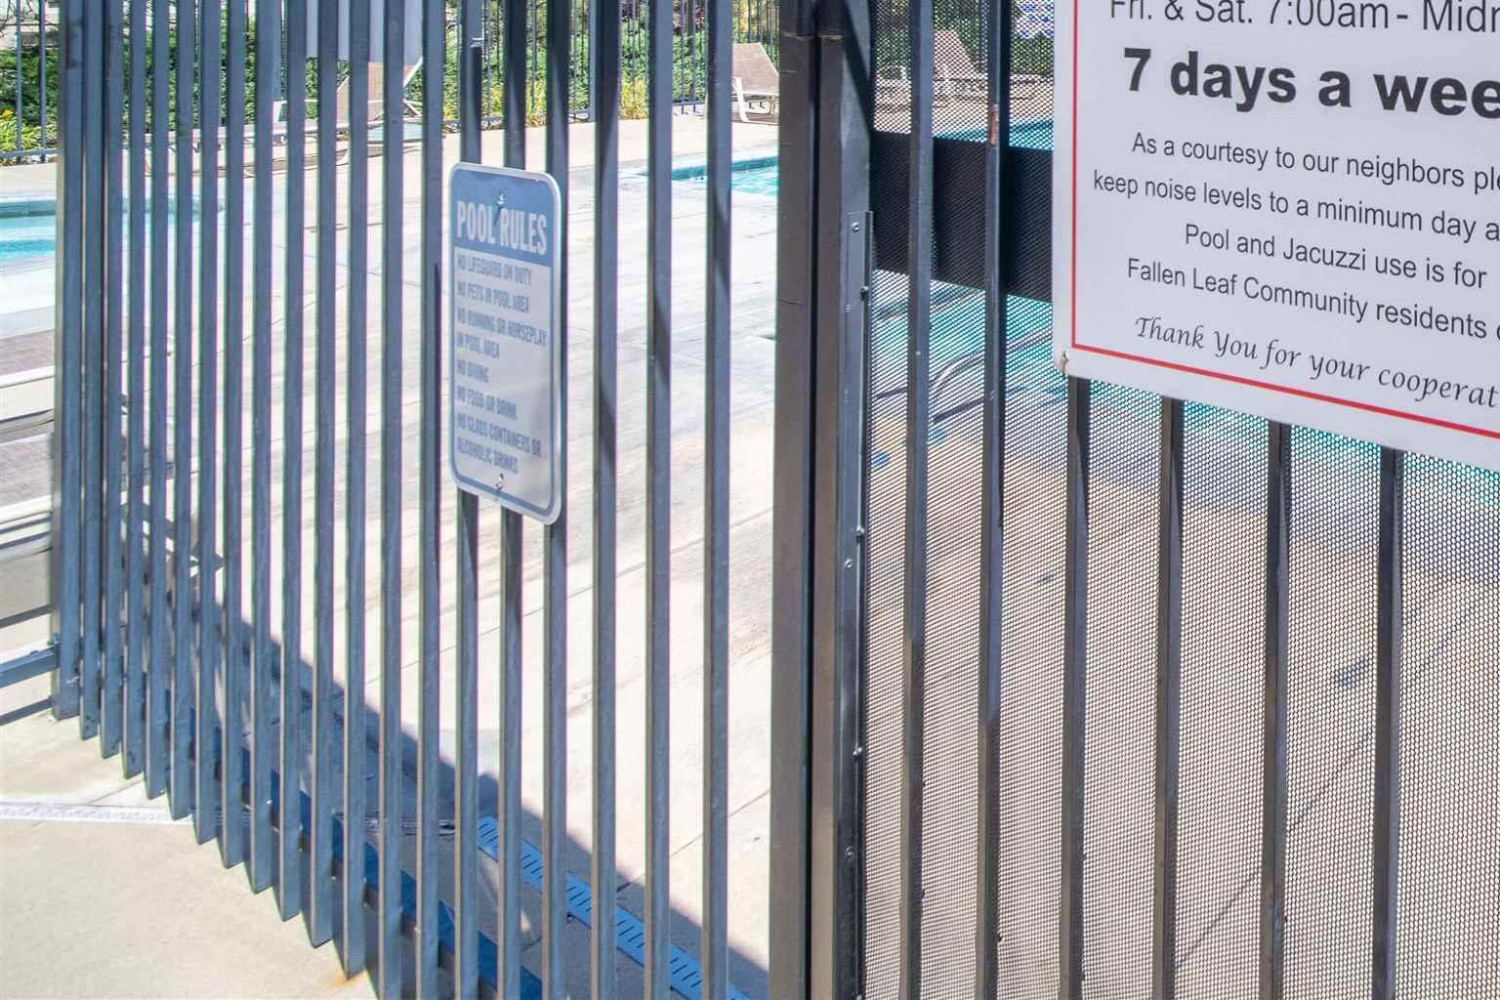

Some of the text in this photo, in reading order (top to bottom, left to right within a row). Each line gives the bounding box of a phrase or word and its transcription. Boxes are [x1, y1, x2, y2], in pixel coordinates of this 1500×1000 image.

[1124, 47, 1152, 91] 7
[1170, 51, 1296, 113] days
[1318, 71, 1352, 108] a
[1132, 132, 1157, 154] As
[1164, 140, 1175, 156] a
[1182, 142, 1268, 171] courtesy
[1275, 147, 1295, 169] to
[1303, 154, 1339, 173] our
[1347, 155, 1464, 187] neighbors
[457, 201, 547, 255] POOL RULES
[1094, 170, 1138, 199] keep
[1145, 178, 1196, 202] noise
[1204, 182, 1262, 210] levels
[1269, 191, 1288, 214] to
[1297, 199, 1309, 216] a
[1318, 198, 1422, 231] minimum
[1431, 211, 1476, 244] day
[1186, 223, 1487, 288] Pool and Jacuzzi use is for
[1128, 258, 1185, 287] Fallen
[1193, 268, 1238, 295] Leaf
[1244, 276, 1368, 323] Community
[1377, 303, 1487, 339] residents
[1135, 316, 1203, 349] Thank
[1214, 331, 1257, 359] You
[1259, 339, 1301, 370] for
[1309, 355, 1370, 380] your
